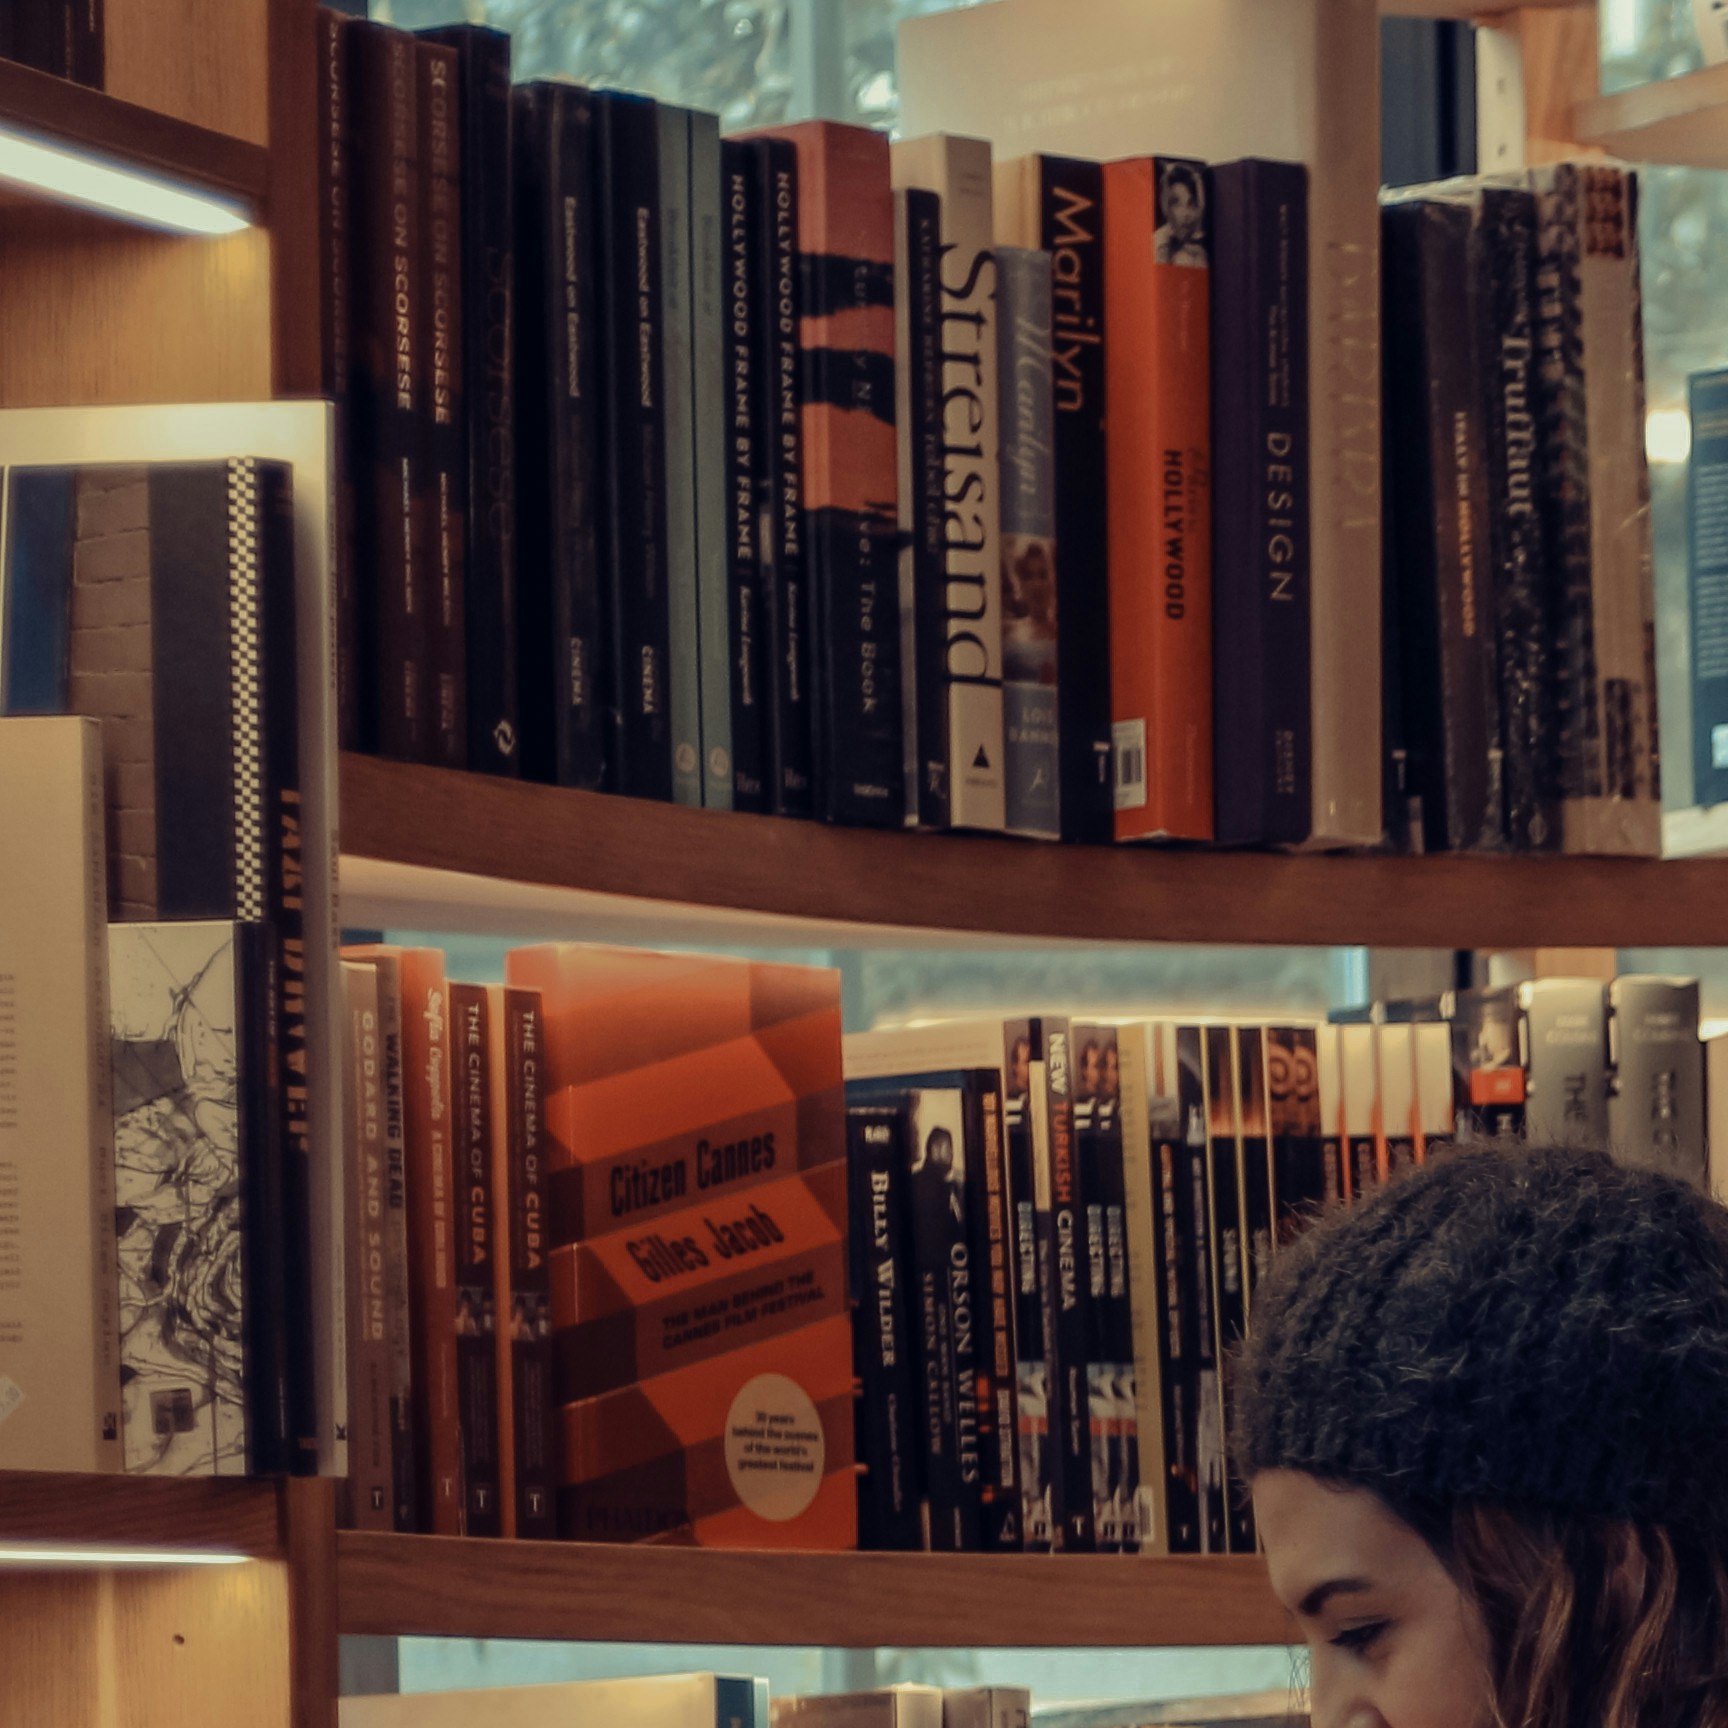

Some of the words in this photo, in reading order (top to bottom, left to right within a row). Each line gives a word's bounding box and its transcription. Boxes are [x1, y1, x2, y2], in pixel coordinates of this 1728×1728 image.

[430, 58, 452, 213] SCORSESE
[393, 203, 410, 249] ON
[431, 217, 452, 263] ON
[563, 196, 578, 283] Eastwood
[636, 206, 652, 294] Eastwood
[732, 174, 749, 338] HOLLYWOOD
[776, 171, 794, 335] HOLLYWOOD
[394, 255, 415, 410] SCORSESE
[565, 285, 578, 307] on
[638, 297, 652, 320] on
[1050, 187, 1101, 412] Marilyn
[432, 269, 453, 425] SCORSESE
[565, 312, 581, 398] Eastwood
[638, 323, 655, 408] Eastwood
[734, 345, 751, 430] FRAME
[779, 342, 797, 428] FRAME
[1005, 314, 1049, 498] Marilyn
[1501, 333, 1536, 518] Truffaut
[735, 437, 752, 466] BY
[780, 436, 797, 466] BY
[941, 243, 1002, 690] Streisand
[736, 474, 753, 562] FRAME
[782, 471, 799, 557] FRAME
[1163, 449, 1185, 621] HOLLYWOOD
[1266, 432, 1294, 602] DESIGN
[859, 580, 876, 634] The
[569, 637, 583, 707] CINEMA
[640, 647, 656, 715] CINEMA
[859, 640, 880, 715] Book
[468, 1003, 481, 1048] THE
[522, 1011, 535, 1051] THE
[1048, 1032, 1066, 1095] NEW
[360, 1009, 379, 1142] GODARD
[384, 1032, 400, 1140] WALKING
[469, 1053, 483, 1147] CINEMA
[523, 1055, 537, 1149] CINEMA
[365, 1152, 382, 1219] AND
[469, 1150, 484, 1181] OF
[524, 1152, 538, 1184] OF
[609, 1151, 687, 1217] Citizen
[695, 1131, 777, 1191] Cannes
[1053, 1100, 1073, 1202] TURKISH
[470, 1188, 487, 1266] CUBA
[525, 1191, 542, 1271] CUBA
[626, 1230, 711, 1284] Gilles
[707, 1204, 785, 1260] Jacob
[869, 1170, 896, 1252] BILLY
[366, 1230, 385, 1341] SOUND
[949, 1241, 973, 1355] ORSON
[1057, 1208, 1079, 1311] CINEMA
[662, 1310, 689, 1330] THE
[693, 1299, 730, 1320] MAN
[732, 1280, 785, 1309] BEHIND
[662, 1317, 721, 1350] CANNES
[873, 1256, 898, 1368] WILDER
[921, 1272, 938, 1351] SIMON
[925, 1360, 943, 1456] CALLOW
[955, 1368, 980, 1485] WELLES
